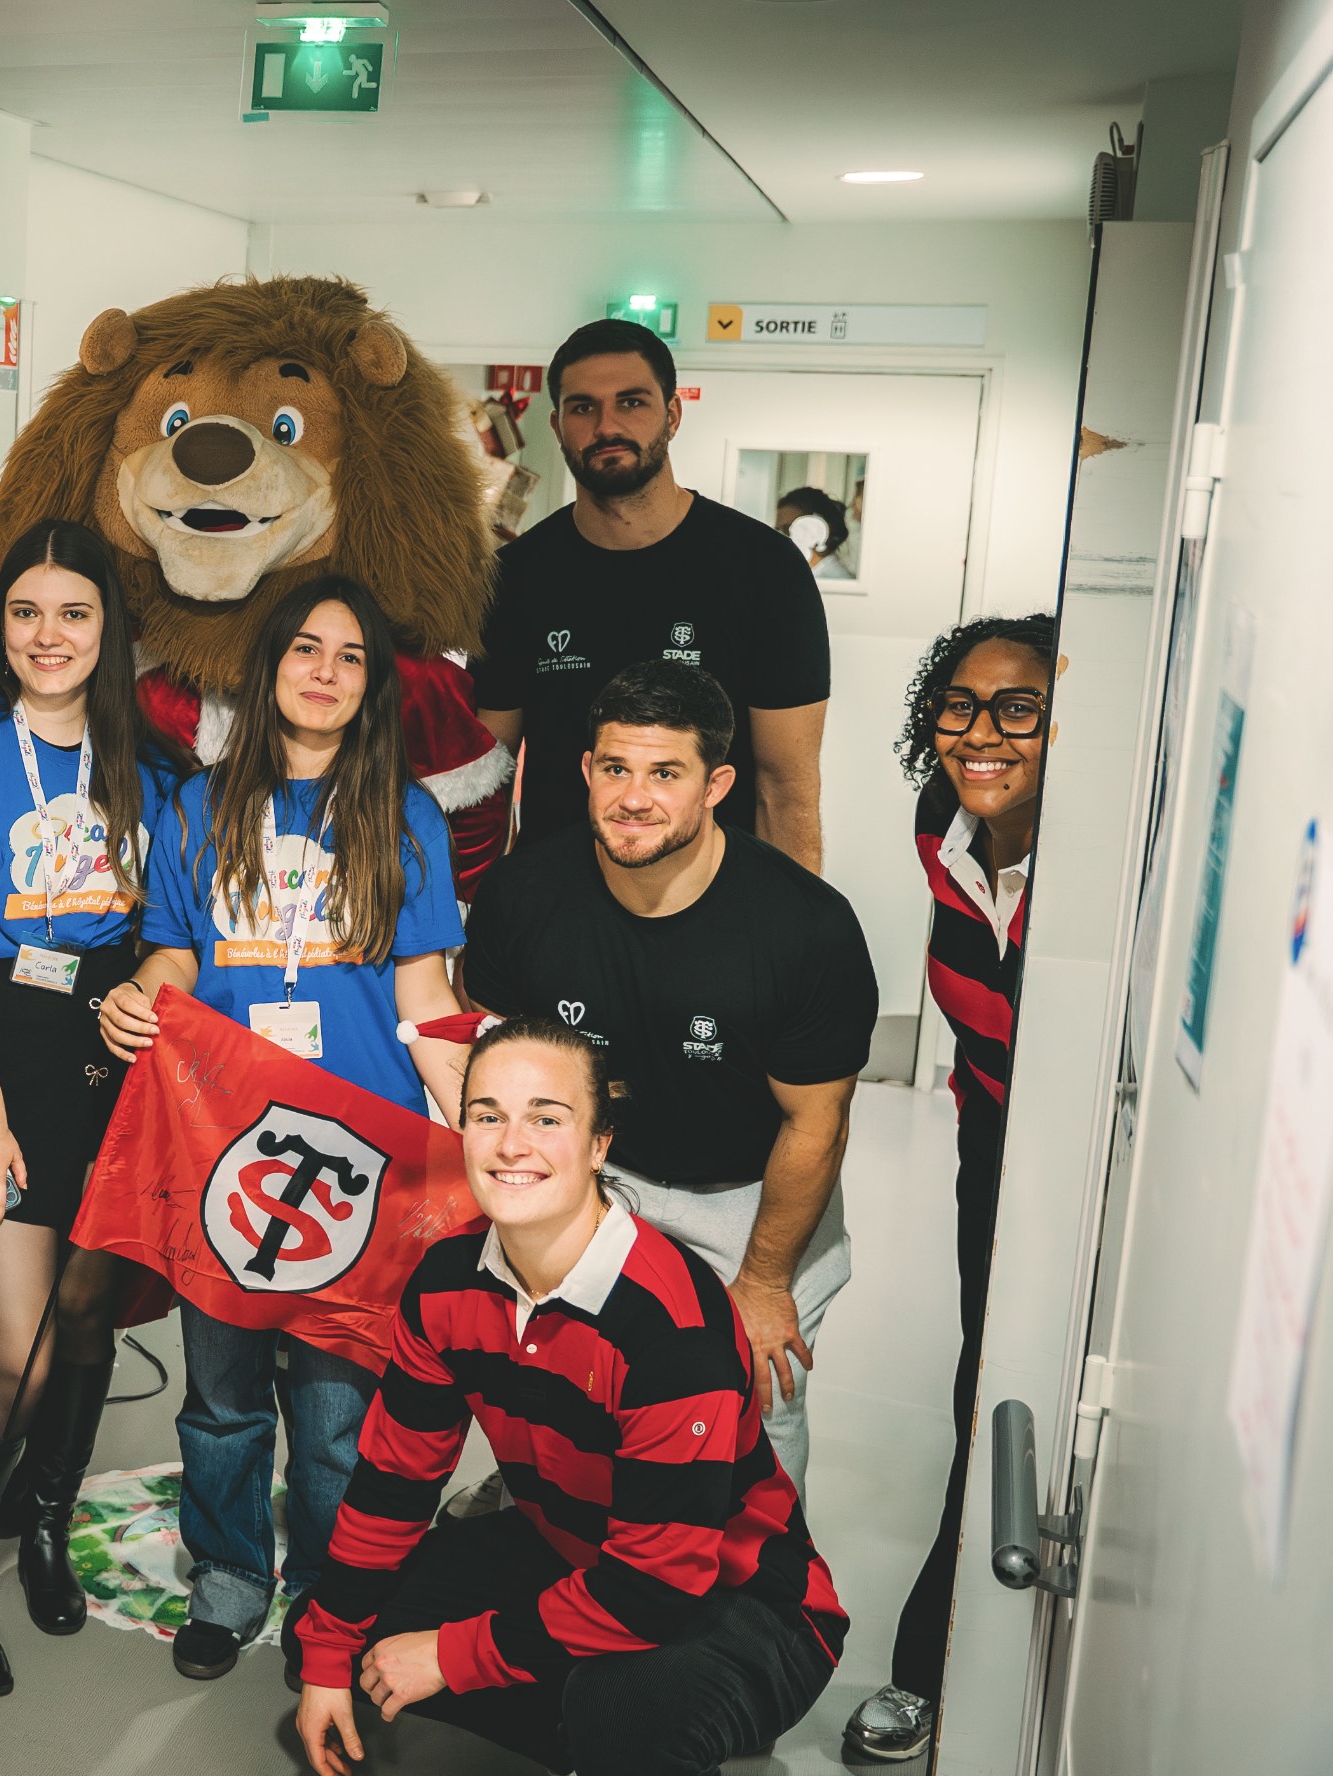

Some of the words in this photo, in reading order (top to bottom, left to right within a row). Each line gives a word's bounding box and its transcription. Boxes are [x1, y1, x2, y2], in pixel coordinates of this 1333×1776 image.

[754, 319, 817, 334] SORTIE
[662, 649, 702, 661] STADE
[227, 947, 265, 959] Bénévoles
[34, 960, 57, 974] Carla
